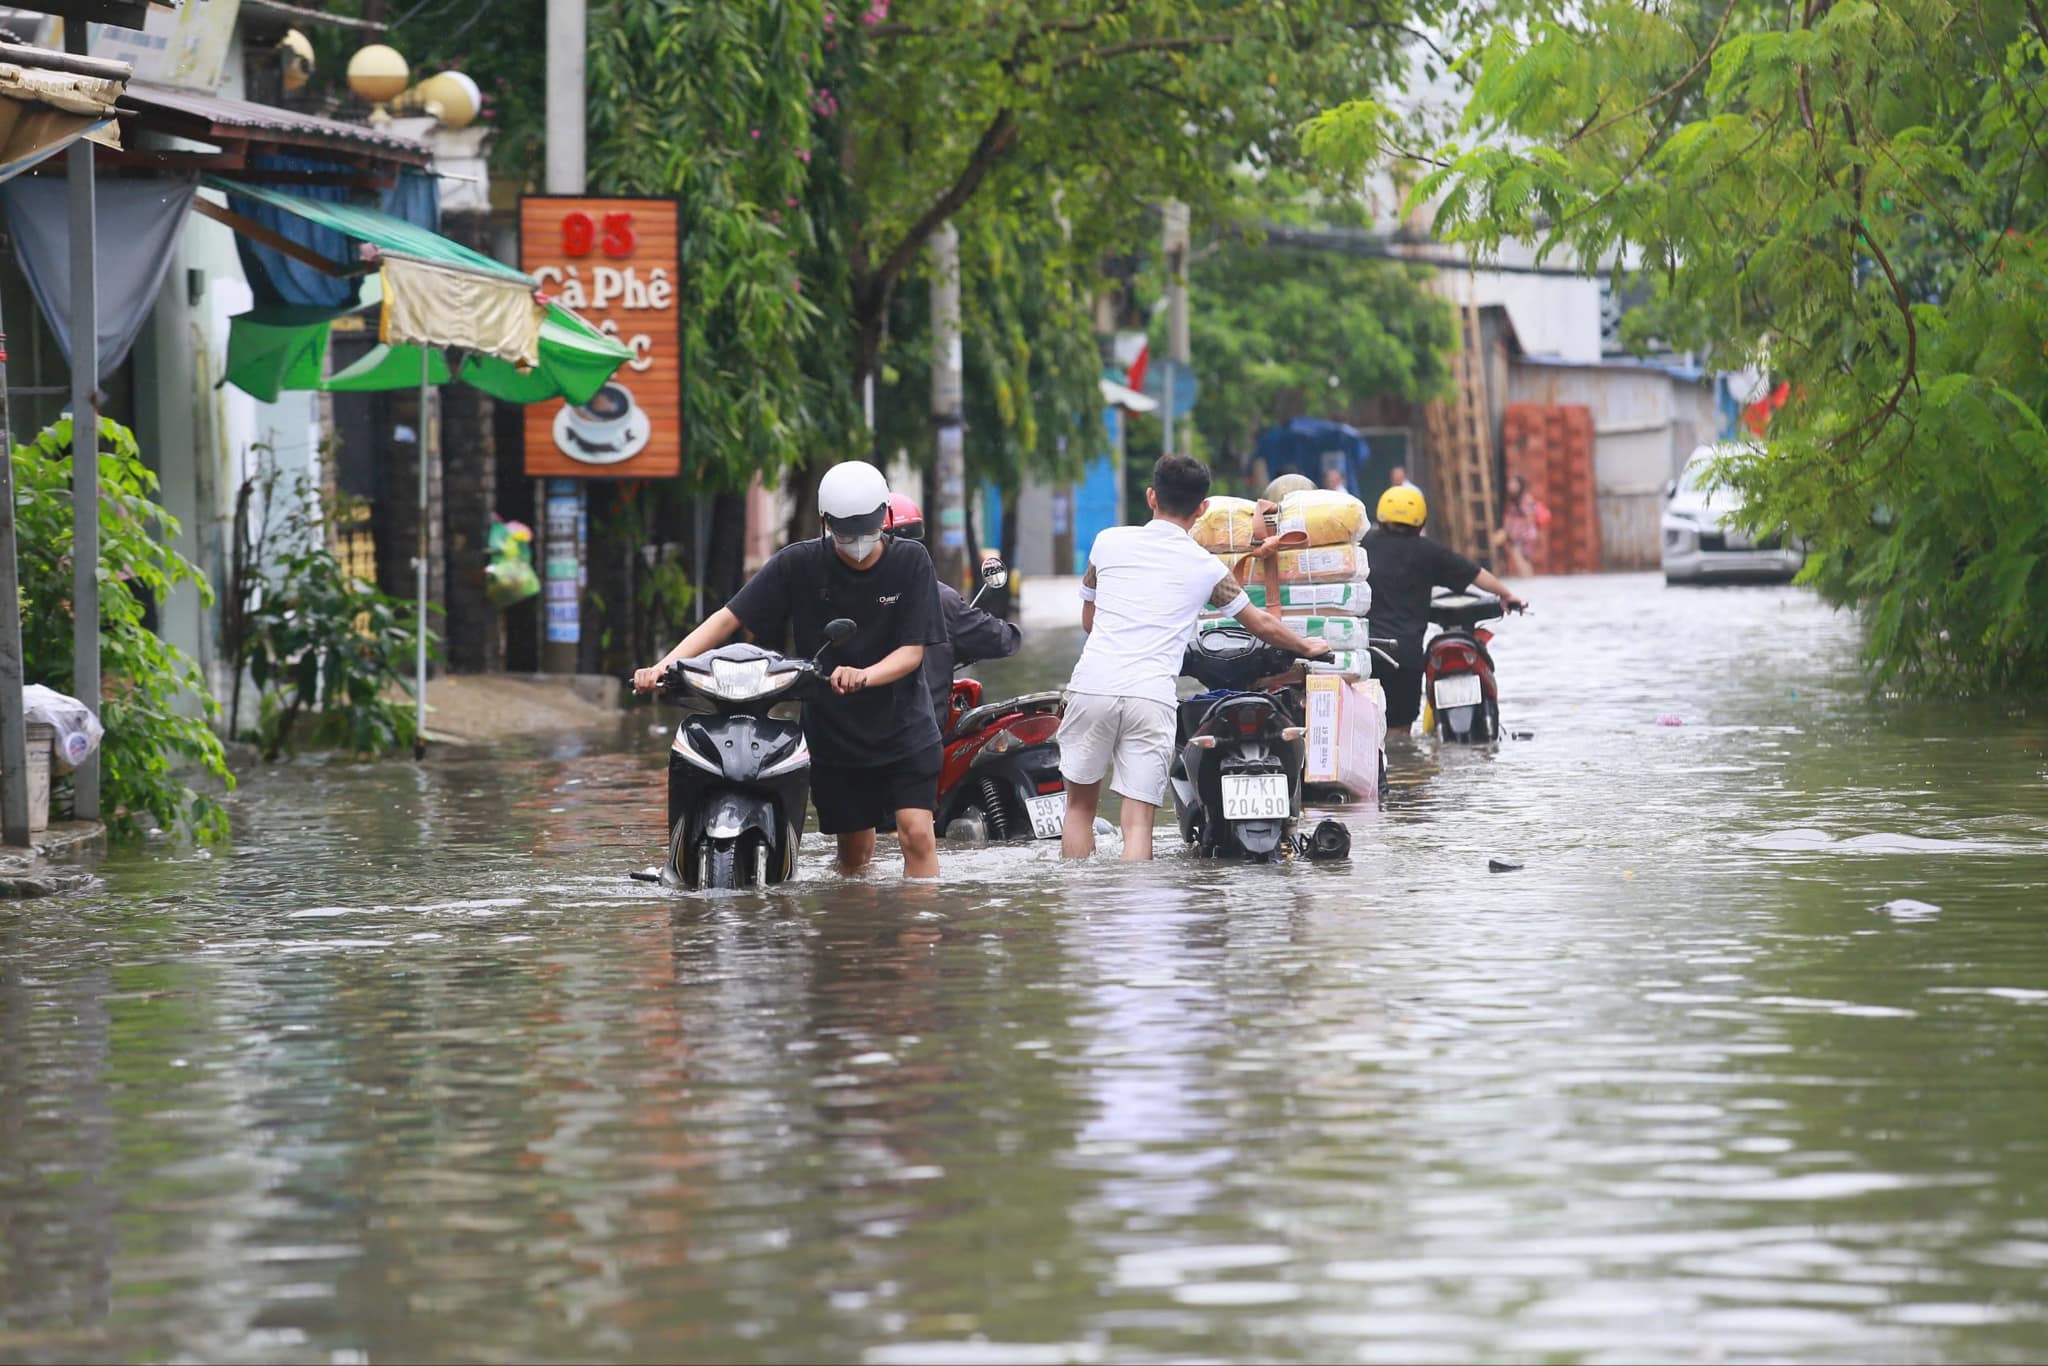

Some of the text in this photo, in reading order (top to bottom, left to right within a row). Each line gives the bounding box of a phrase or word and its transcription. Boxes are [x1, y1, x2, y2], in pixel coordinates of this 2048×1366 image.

[533, 265, 673, 310] Cà Phê
[1228, 798, 1285, 817] 204.90
